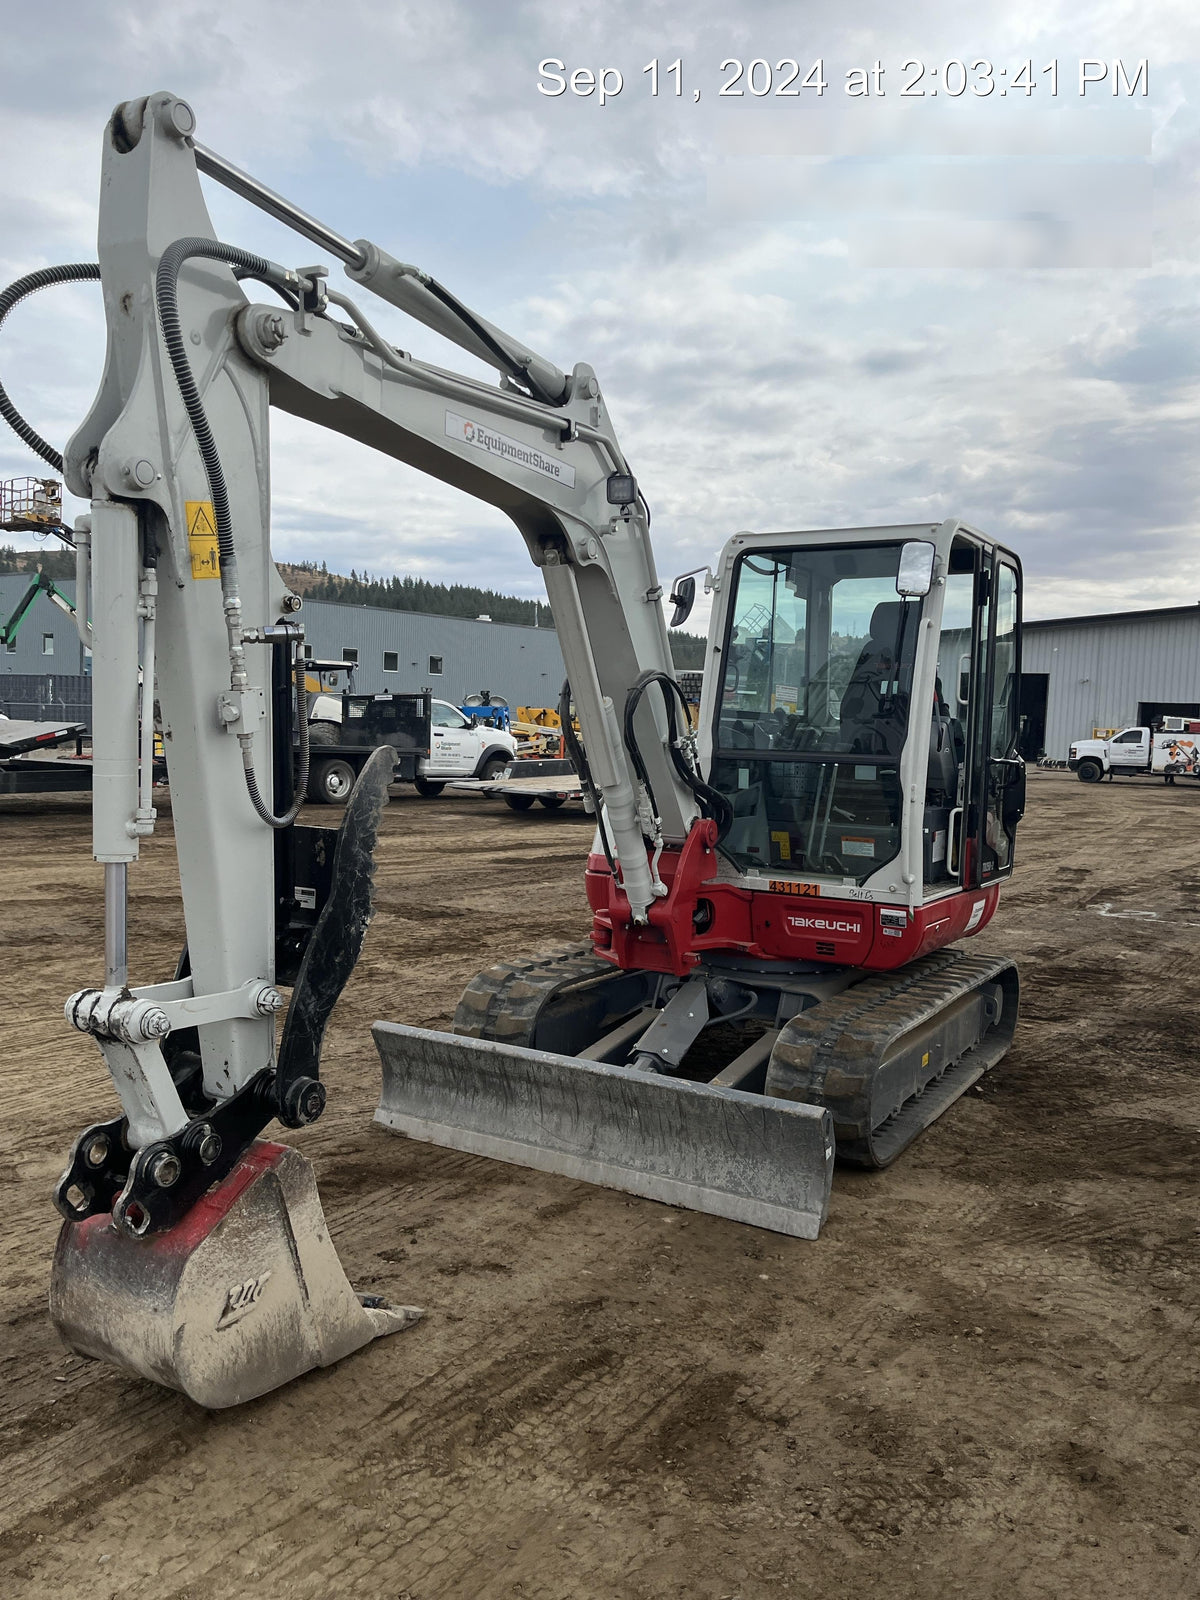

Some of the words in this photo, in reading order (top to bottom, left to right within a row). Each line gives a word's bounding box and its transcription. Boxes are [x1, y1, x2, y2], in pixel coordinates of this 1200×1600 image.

[476, 427, 560, 477] EquipmentShare
[769, 881, 819, 896] 431121
[787, 917, 860, 933] TAKEUCHI
